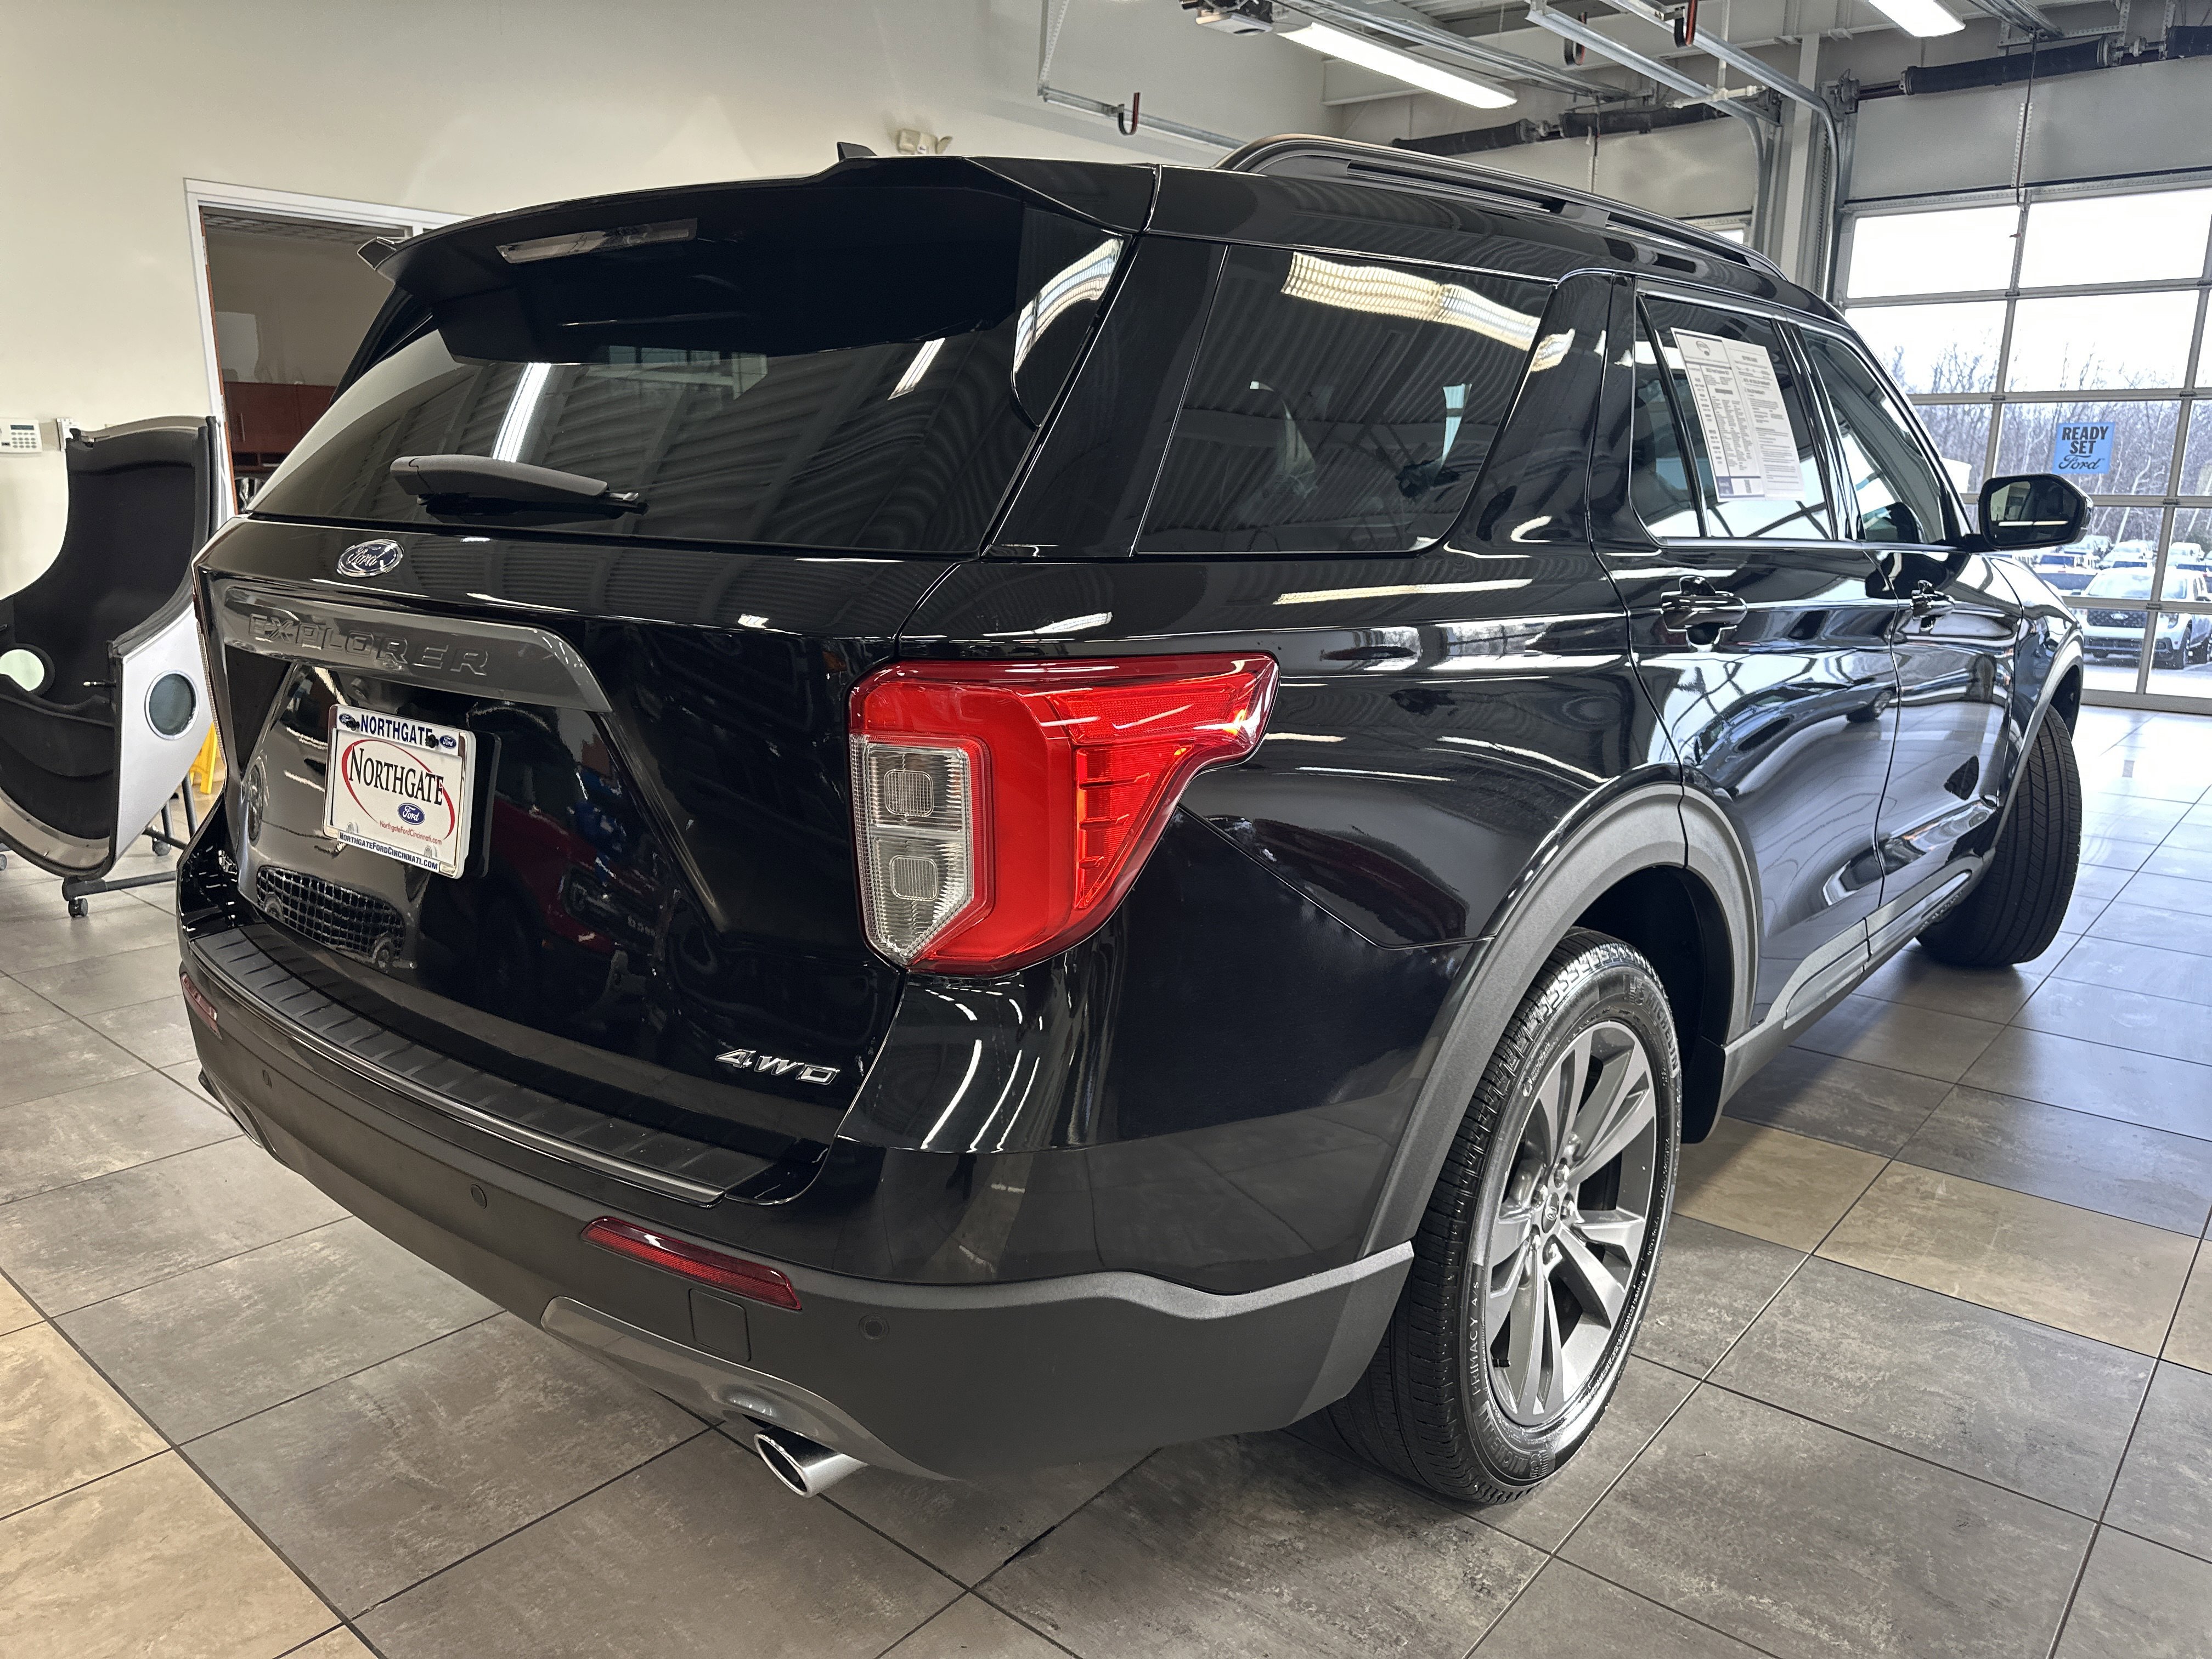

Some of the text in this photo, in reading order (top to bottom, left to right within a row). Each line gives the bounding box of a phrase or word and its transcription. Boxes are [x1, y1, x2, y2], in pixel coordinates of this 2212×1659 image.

[2062, 426, 2109, 441] READY
[2069, 441, 2096, 454] SET
[2058, 454, 2102, 470] Ford
[249, 612, 489, 676] EXPLORER
[442, 737, 454, 747] Ford
[348, 746, 444, 806] NORTHGATE
[402, 805, 420, 822] Ford
[380, 820, 442, 846] NorthgateFordCincinnati.com
[1646, 992, 1678, 1071] MICHELIN
[715, 1049, 840, 1085] 4WD
[1470, 1317, 1481, 1396] PRIMACY
[1477, 1409, 1529, 1475] MICHELIN
